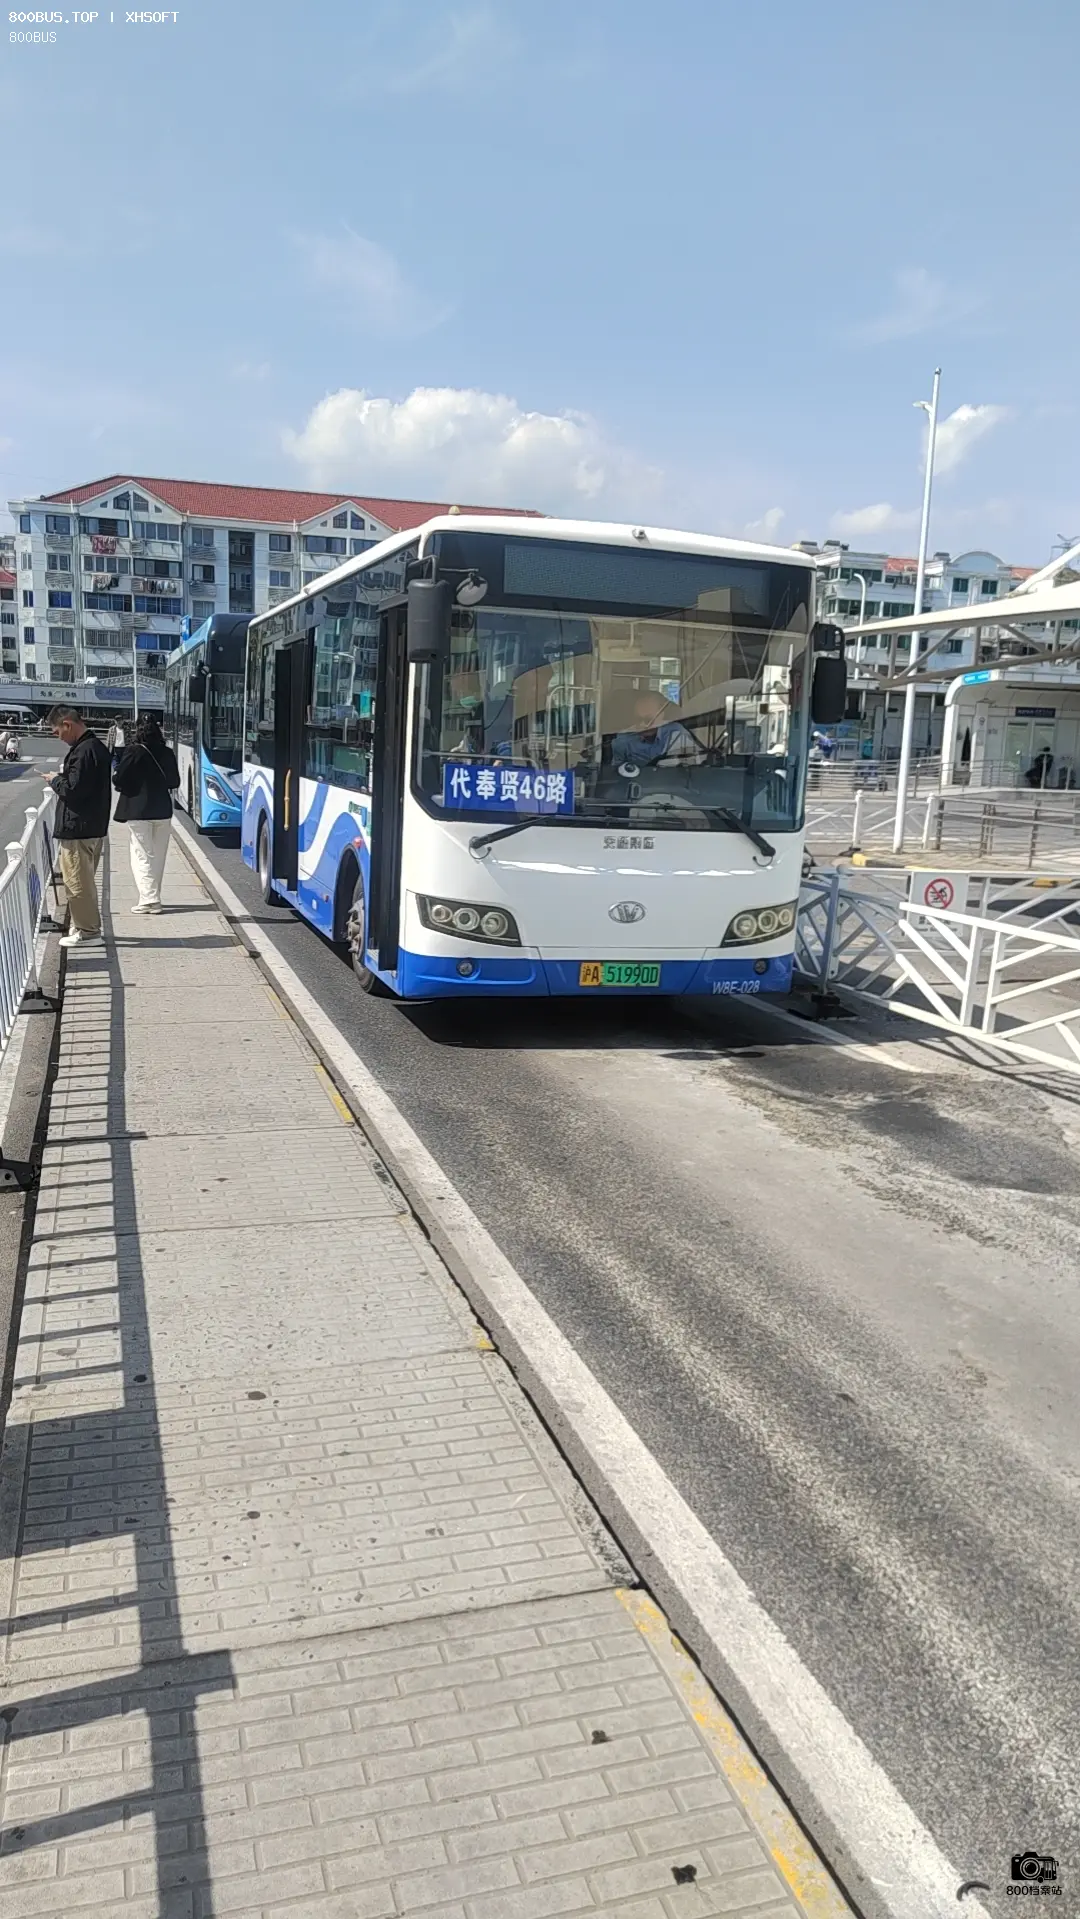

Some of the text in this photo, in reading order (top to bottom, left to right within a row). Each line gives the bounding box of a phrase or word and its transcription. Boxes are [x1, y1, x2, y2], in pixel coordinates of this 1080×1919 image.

[450, 768, 567, 804] 代奉贤46路
[712, 980, 760, 994] W8E-028
